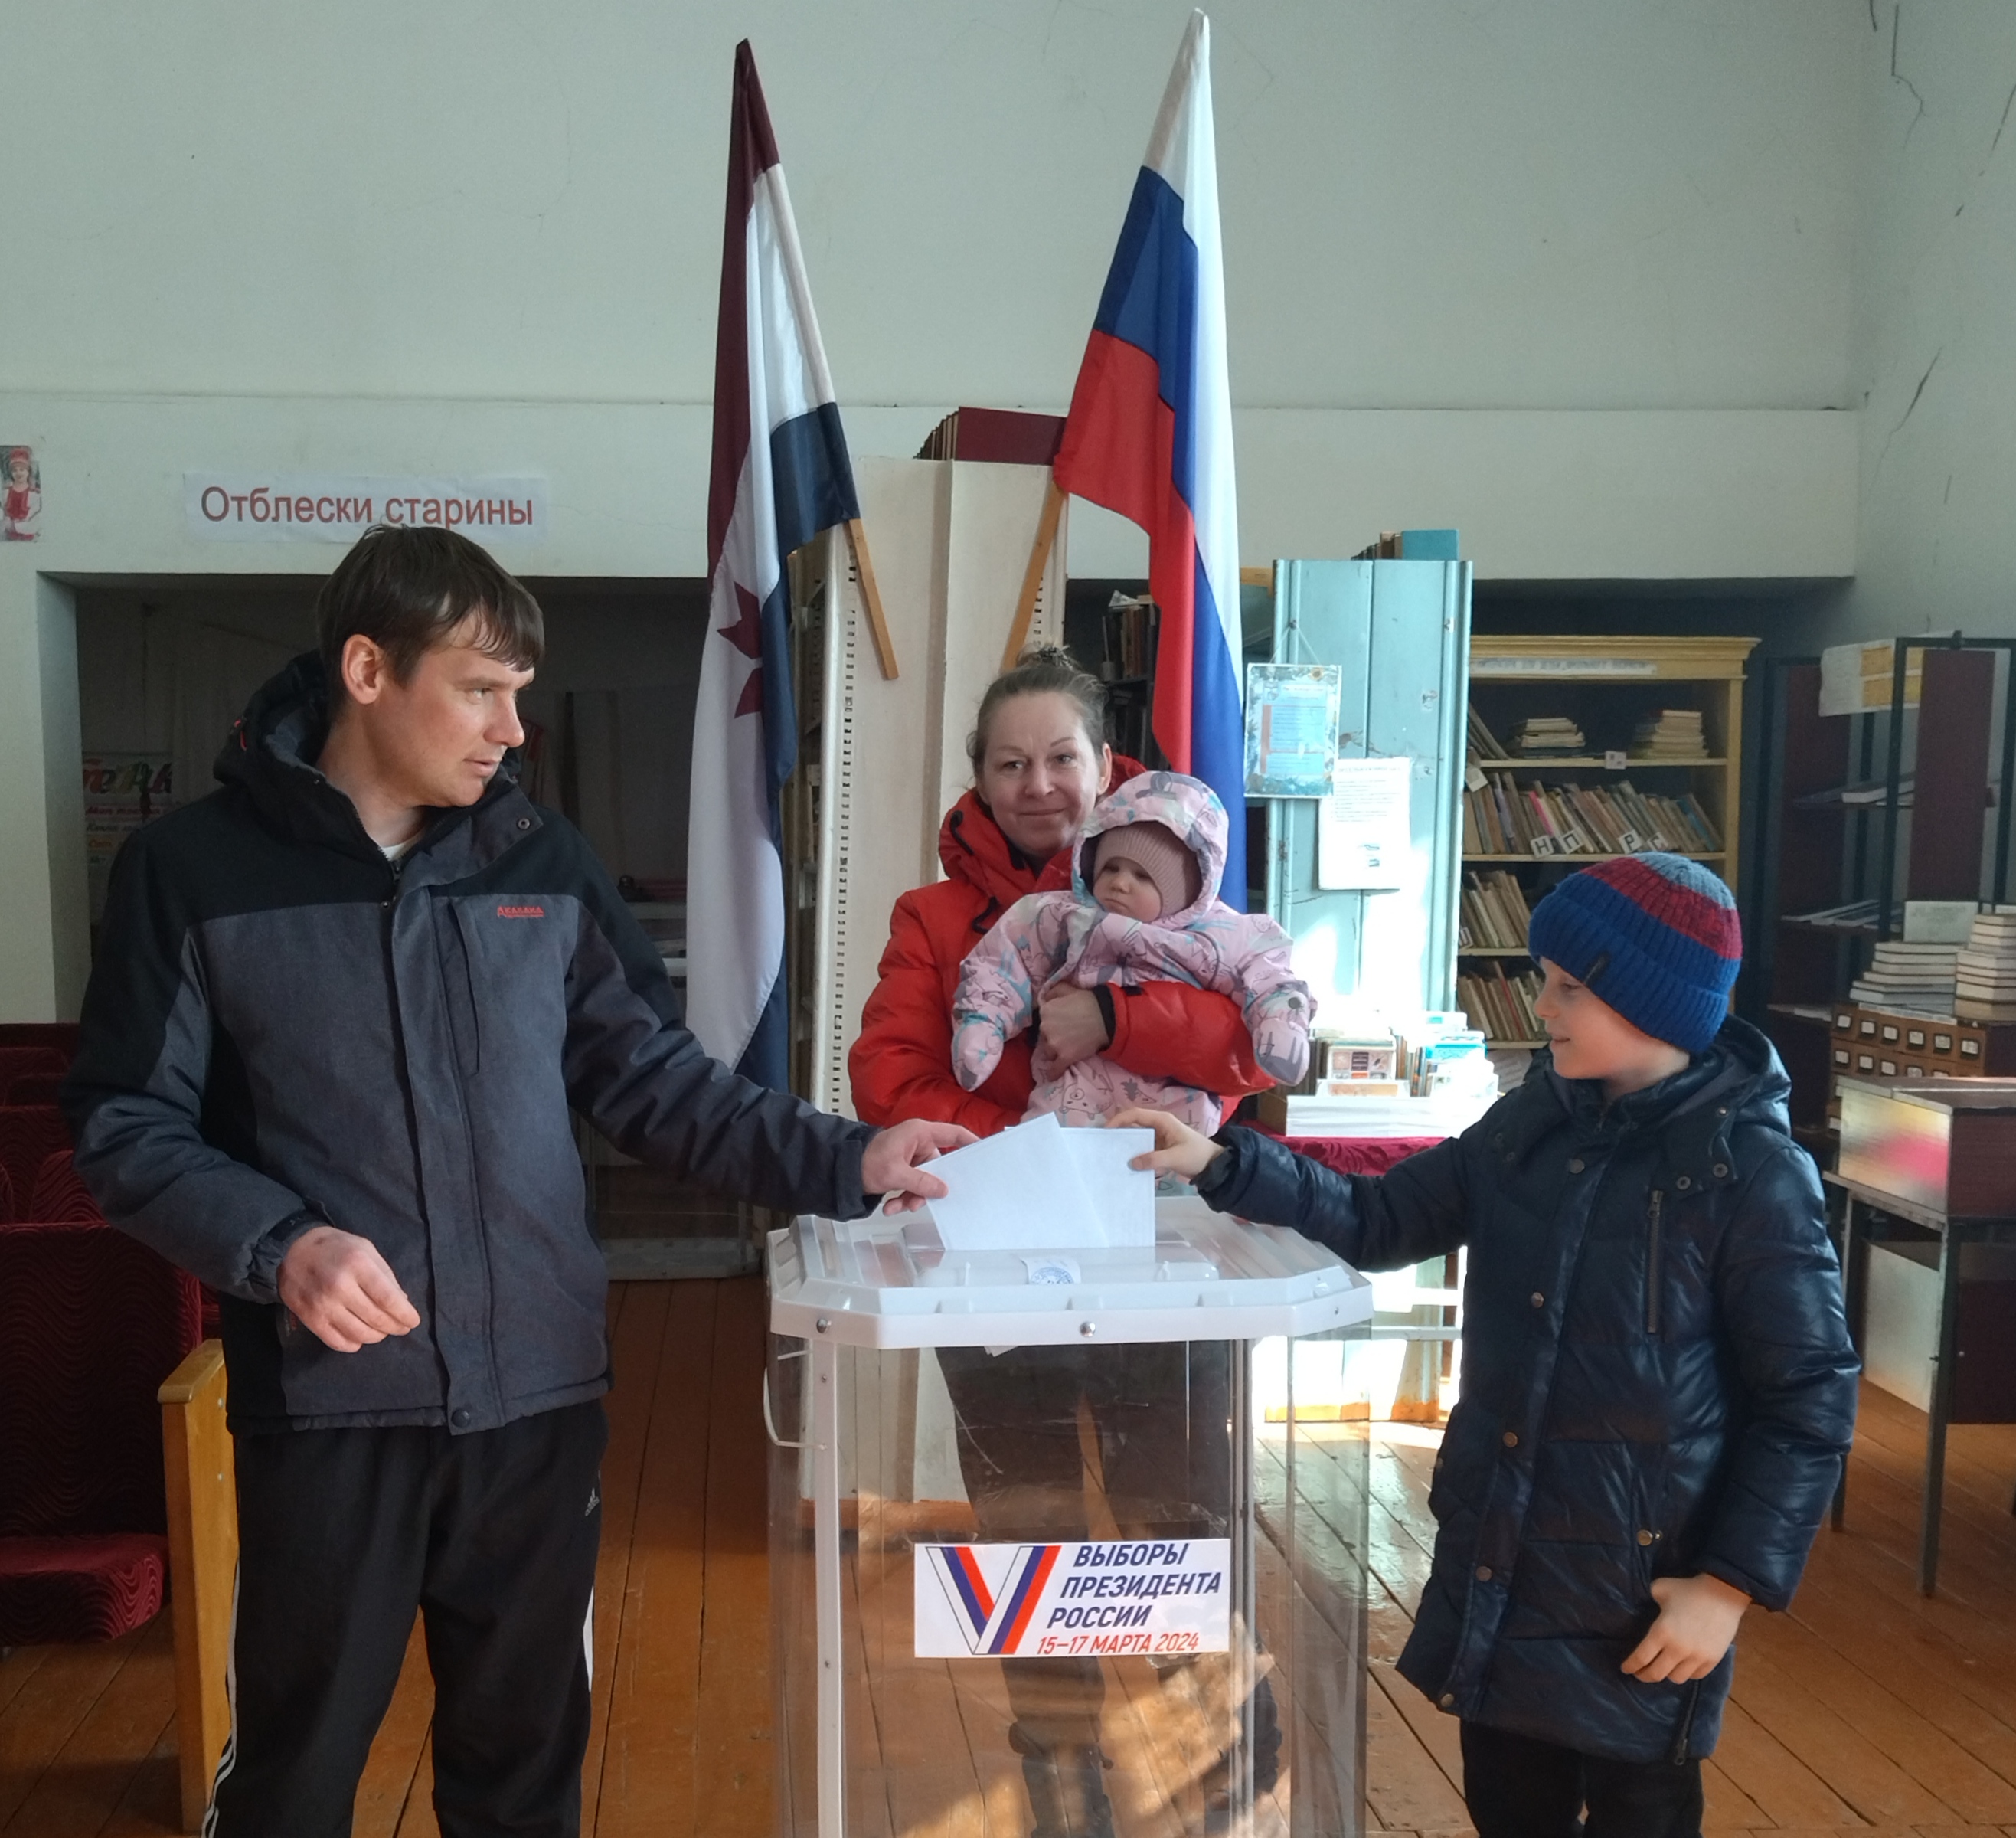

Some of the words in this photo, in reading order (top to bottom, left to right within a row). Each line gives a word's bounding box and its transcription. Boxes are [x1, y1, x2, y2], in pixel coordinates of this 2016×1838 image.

[201, 486, 373, 523] Отблески
[384, 497, 534, 528] старины
[1563, 832, 1580, 849] П
[1624, 834, 1635, 851] Р
[1073, 1542, 1190, 1567] ВЫБОРЫ
[1060, 1571, 1222, 1599] ПРЕЗИДЕНТА
[1047, 1604, 1153, 1629] РОССИИ
[1090, 1634, 1152, 1654] МАРТА
[1154, 1632, 1199, 1652] 2024
